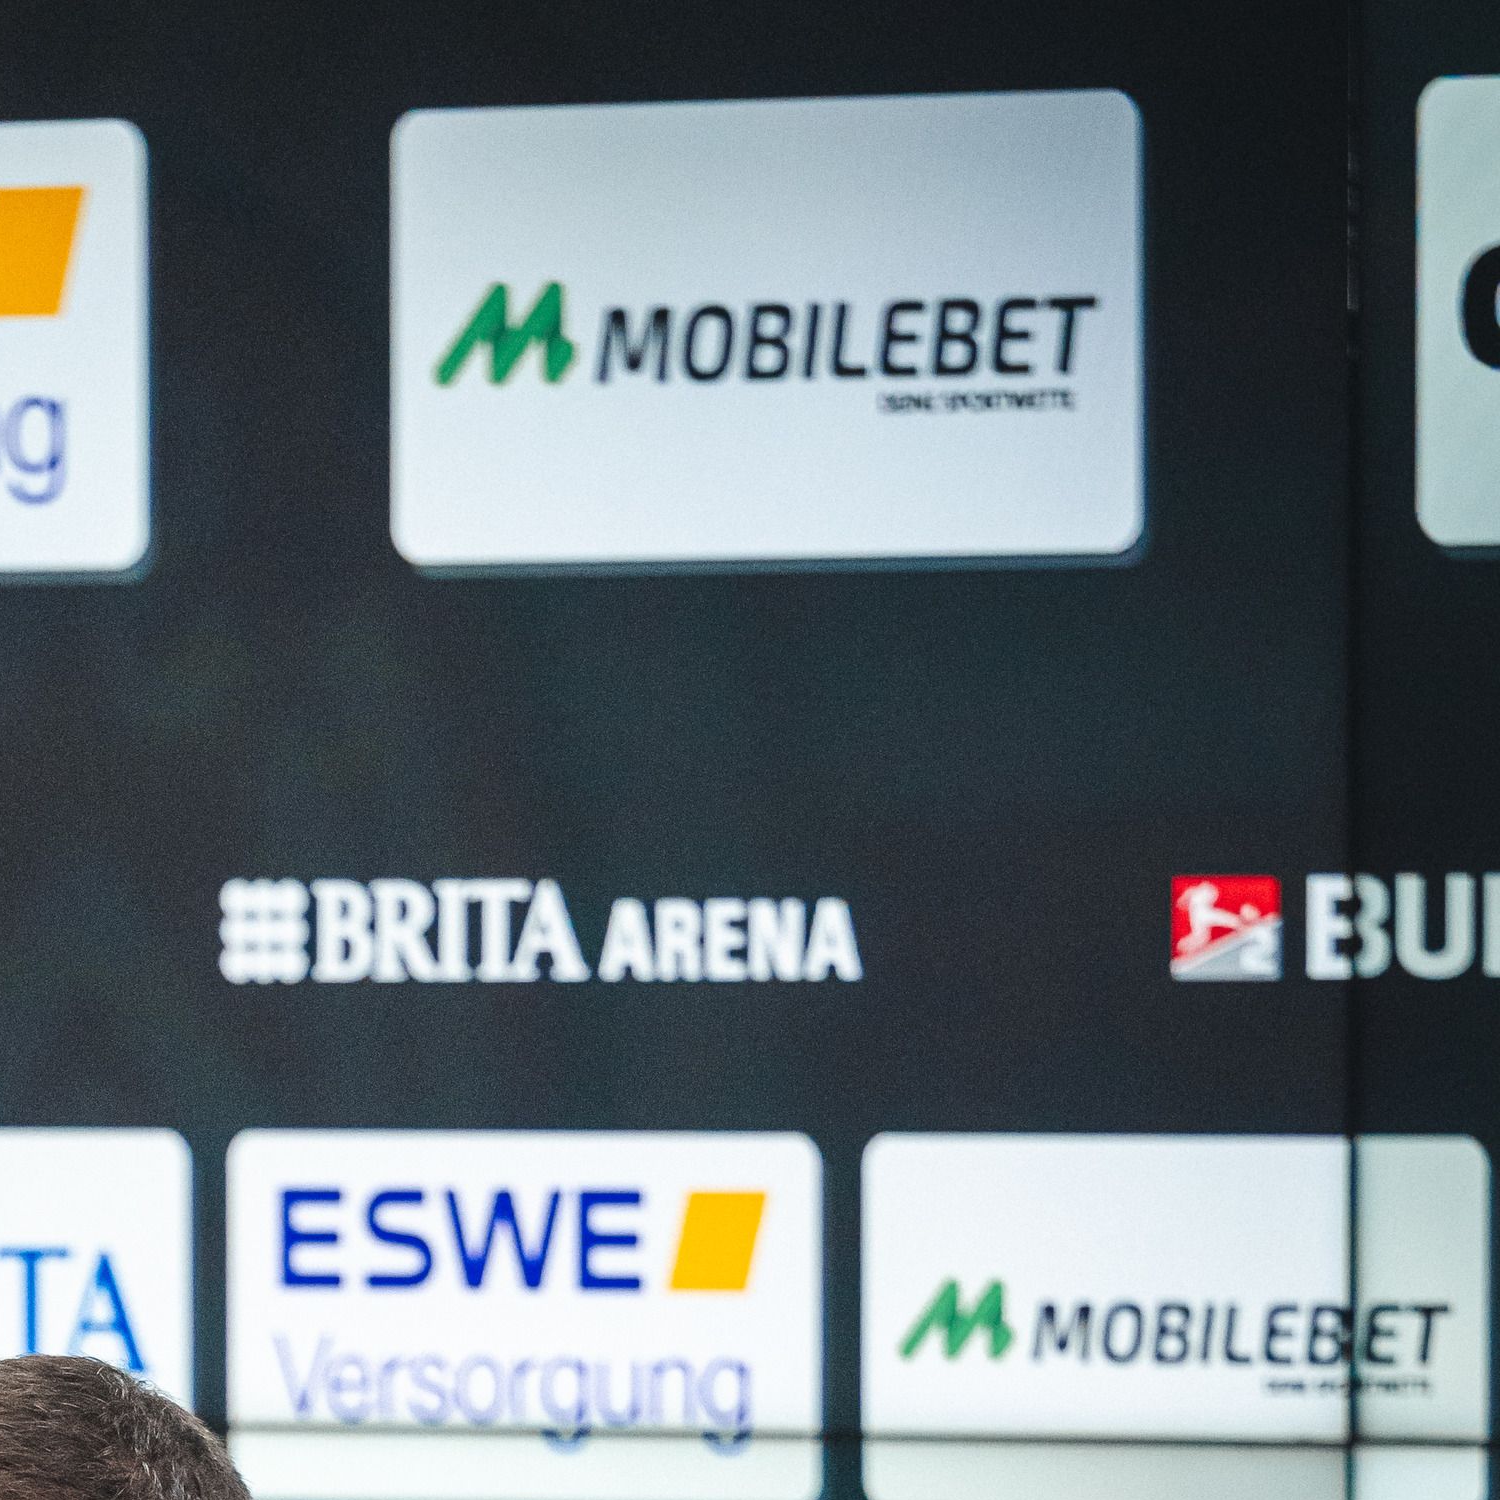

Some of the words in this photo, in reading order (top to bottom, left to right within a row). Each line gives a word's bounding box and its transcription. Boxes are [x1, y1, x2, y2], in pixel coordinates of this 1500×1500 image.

[596, 296, 1097, 384] MOBILEBET
[311, 877, 590, 984] BRITA
[598, 896, 863, 983] ARENA
[278, 1189, 641, 1289] ESWE
[1030, 1302, 1451, 1366] MOBILEBET
[273, 1333, 753, 1453] Versorgung
